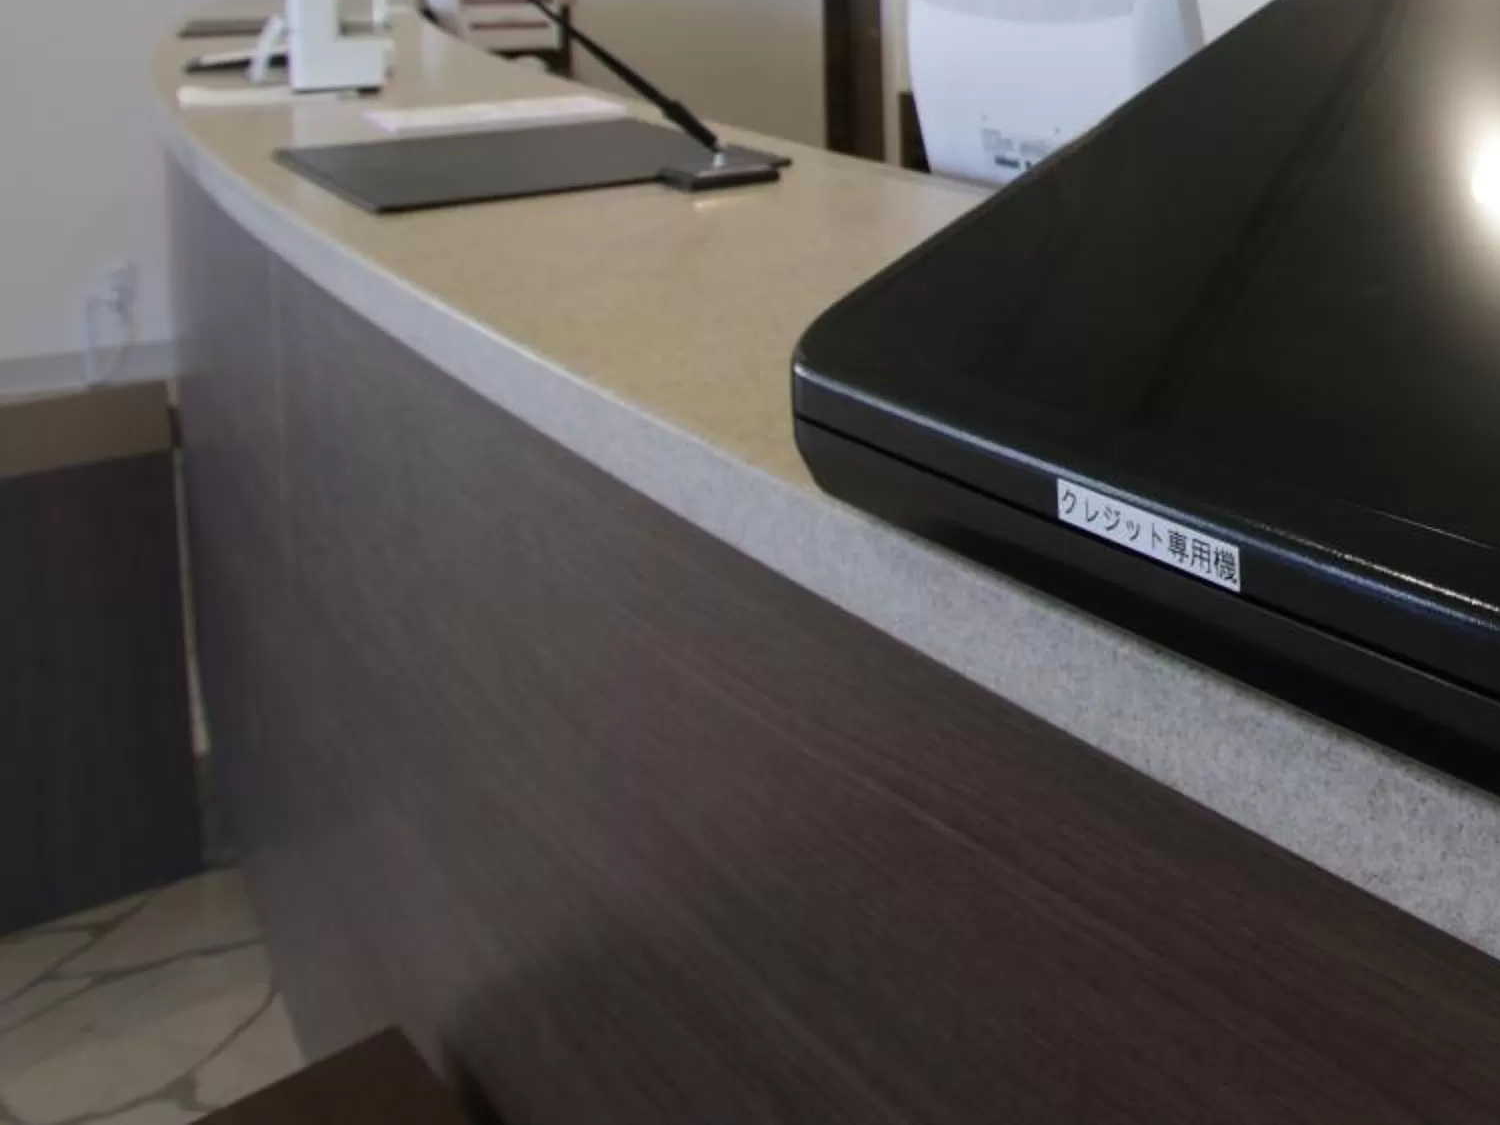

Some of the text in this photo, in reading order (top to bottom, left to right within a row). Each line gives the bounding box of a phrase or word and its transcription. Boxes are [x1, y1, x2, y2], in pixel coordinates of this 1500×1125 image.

[1061, 489, 1238, 585] クレジット専用機
